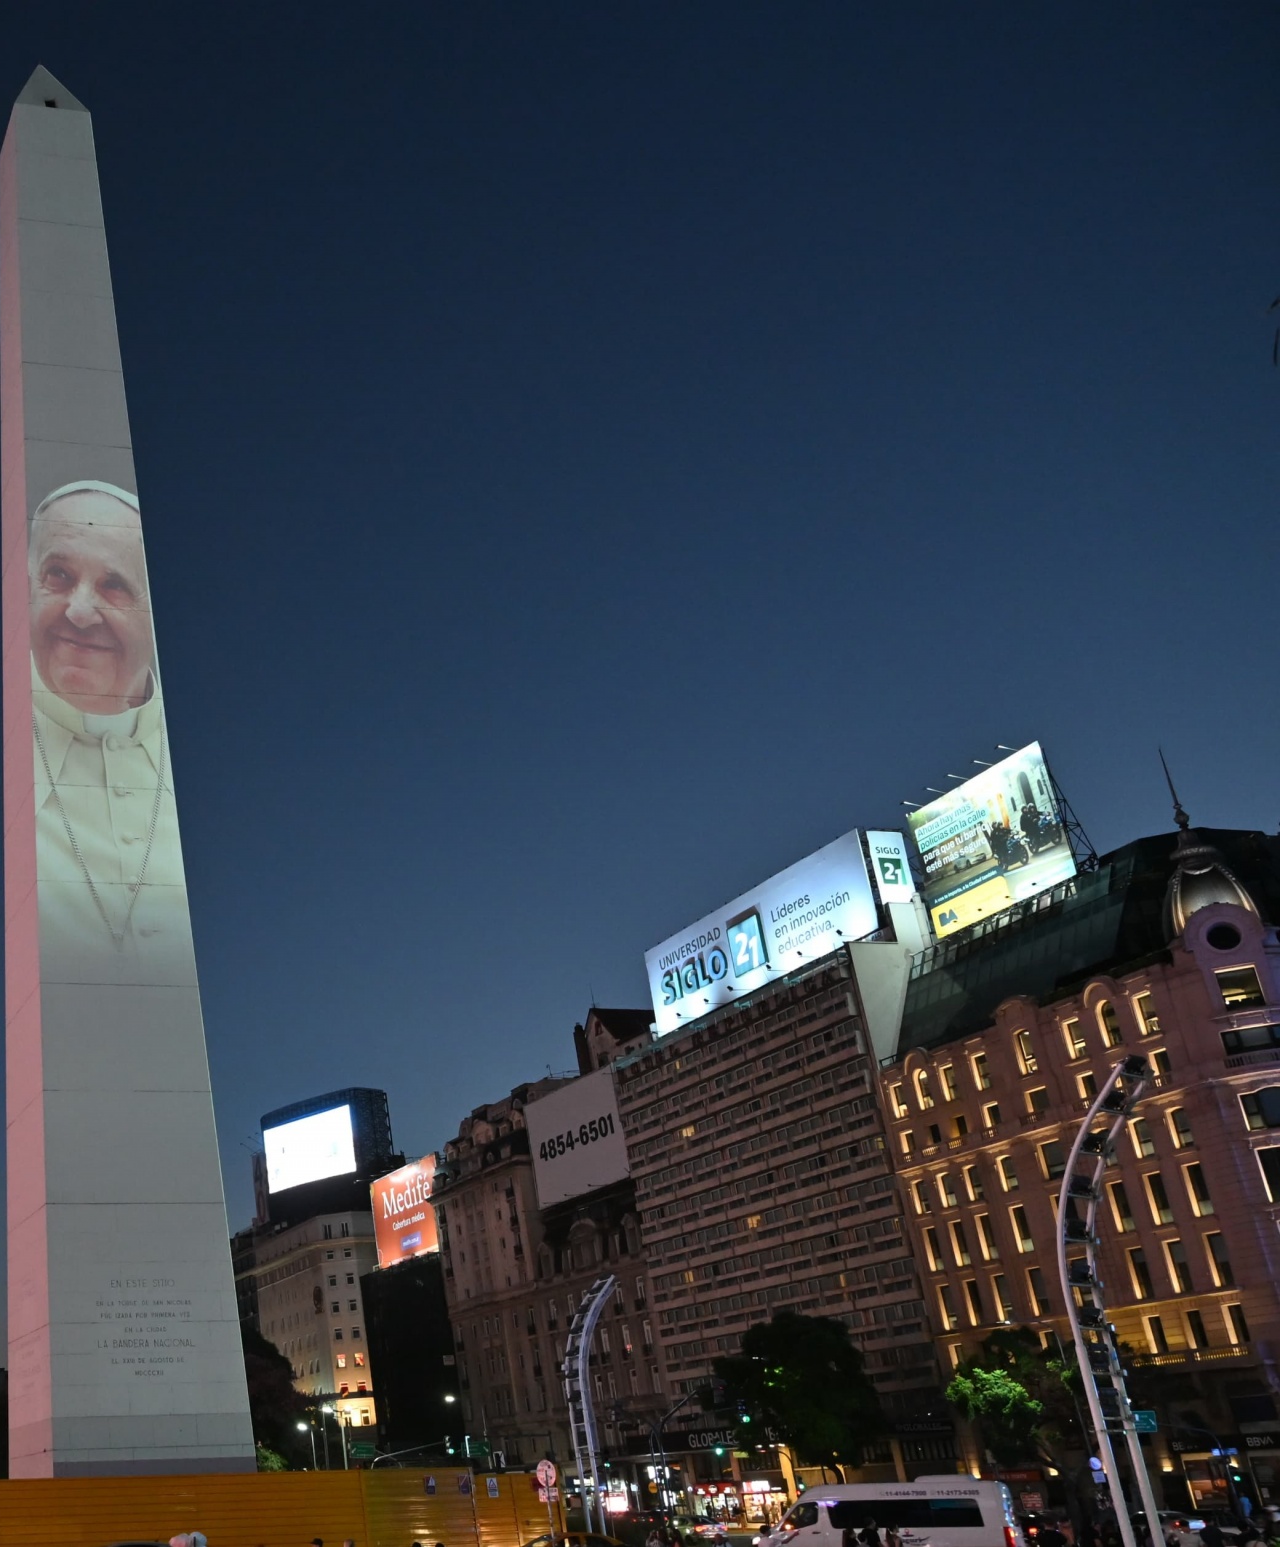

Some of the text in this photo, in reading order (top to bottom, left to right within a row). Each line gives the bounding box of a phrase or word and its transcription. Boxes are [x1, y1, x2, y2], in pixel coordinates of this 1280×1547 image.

[949, 825, 959, 834] en
[959, 820, 968, 831] la
[967, 809, 986, 822] calle
[875, 846, 900, 855] SIGLO
[923, 822, 988, 865] para que tu barrio
[926, 838, 986, 874] esté más seguro
[883, 862, 904, 885] 21
[770, 894, 811, 923] Líderes
[774, 891, 851, 938] en innovación
[938, 908, 958, 927] BA
[658, 927, 721, 970] UNIVERSIDAD
[735, 932, 759, 968] 21
[778, 920, 835, 954] educativa.
[661, 946, 728, 1006] SIGLO
[540, 1113, 615, 1161] 4854-6501
[381, 1173, 431, 1219] Medifé
[393, 1218, 411, 1230] Cobertura
[110, 1278, 175, 1288] EN ESTE SITIO
[97, 1338, 195, 1349] LA BANDERA NACIONAL
[1246, 1436, 1274, 1447] BBVA
